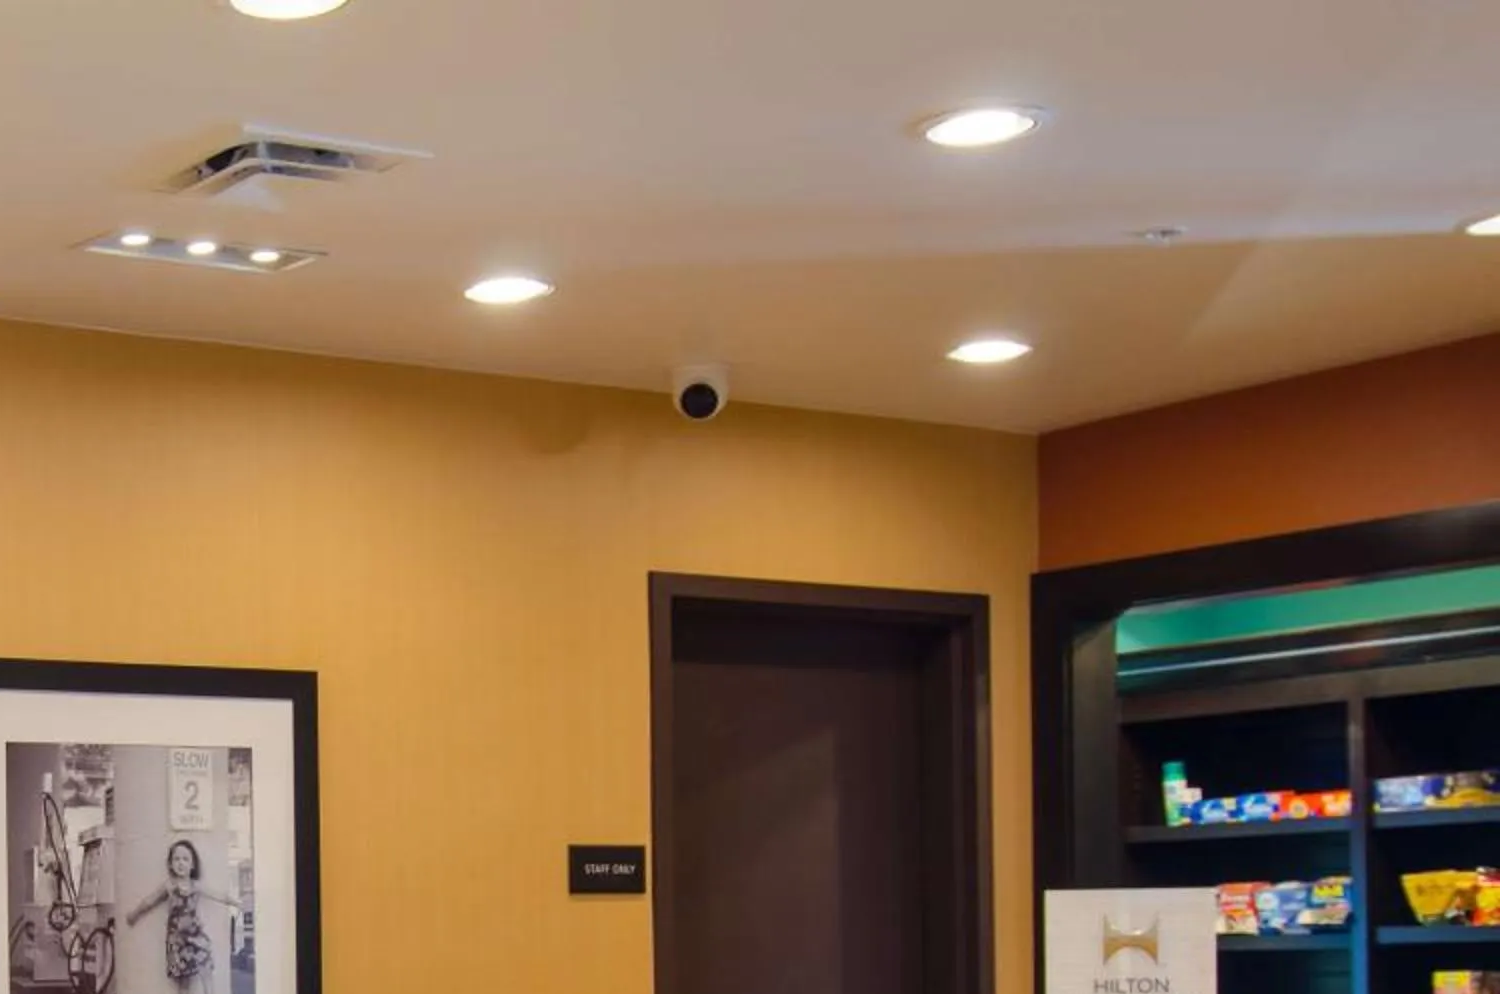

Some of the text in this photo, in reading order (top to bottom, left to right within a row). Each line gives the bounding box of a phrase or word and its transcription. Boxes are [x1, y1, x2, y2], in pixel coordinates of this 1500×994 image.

[173, 750, 210, 768] SLOW
[184, 780, 200, 810] 2
[584, 863, 636, 875] STAFF ONLY
[1094, 976, 1170, 994] HILTON
